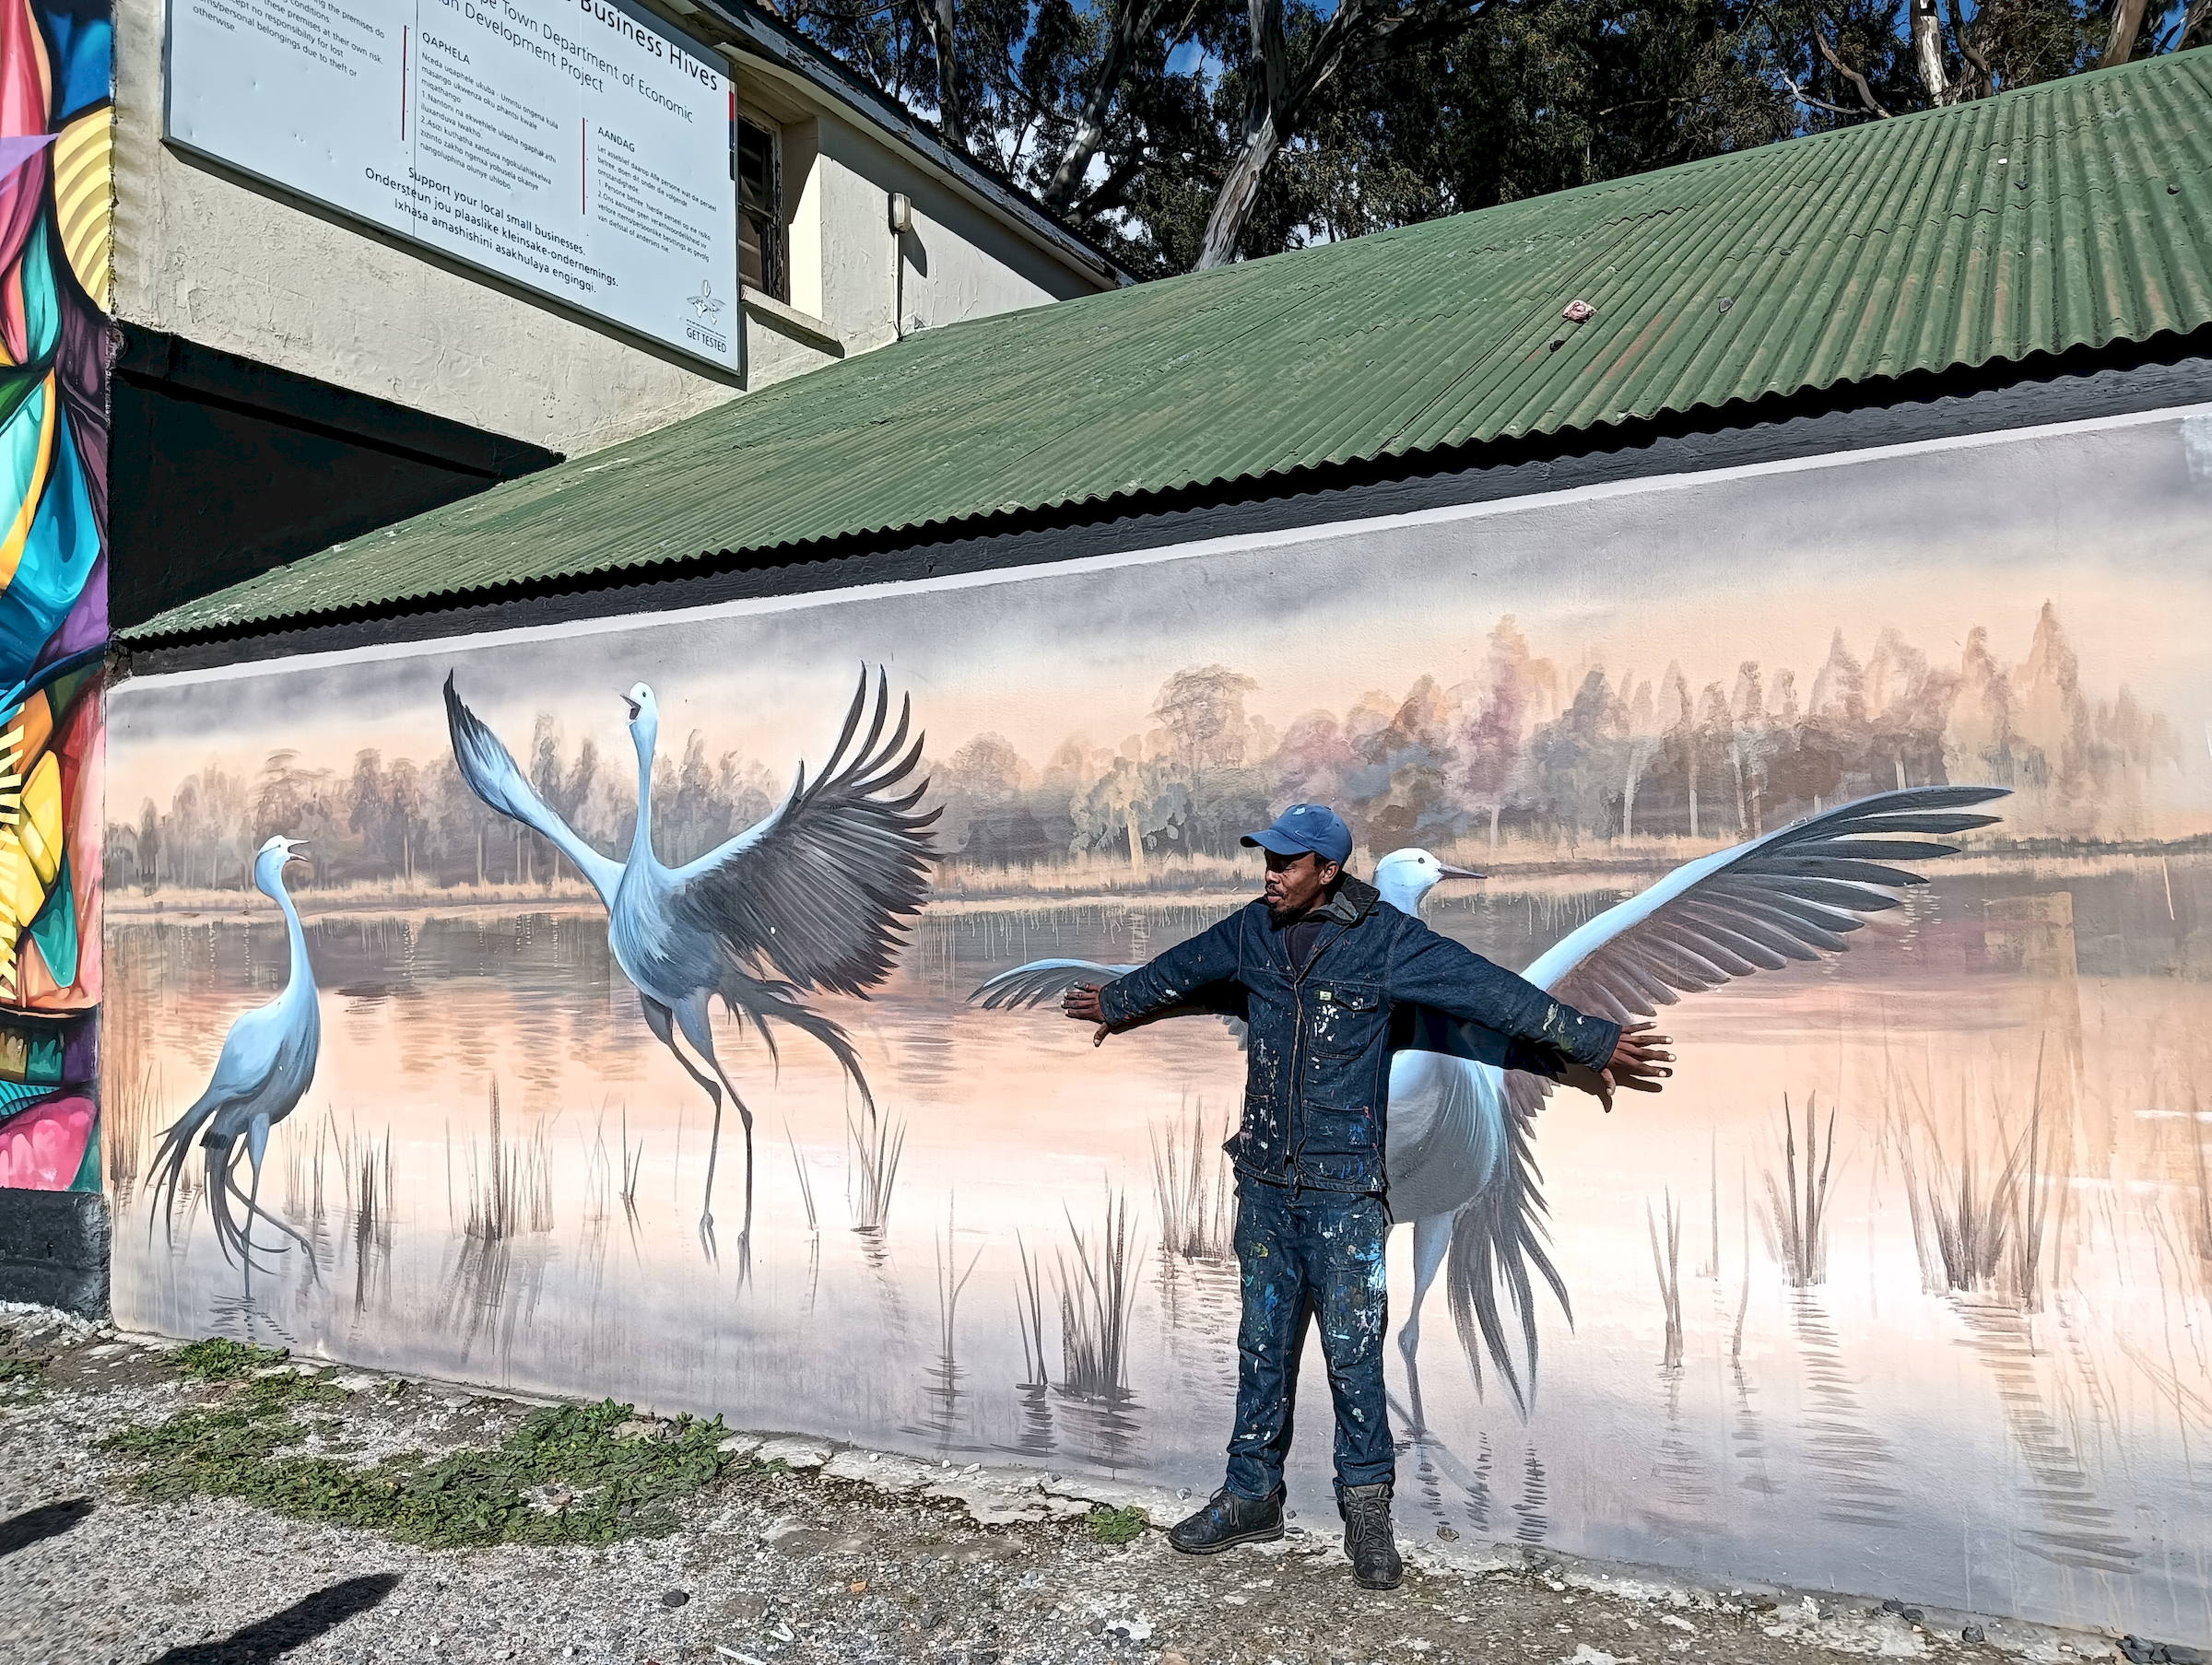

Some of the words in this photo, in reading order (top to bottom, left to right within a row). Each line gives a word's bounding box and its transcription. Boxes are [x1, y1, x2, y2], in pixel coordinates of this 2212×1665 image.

[422, 32, 470, 65] QAPHELA
[464, 2, 557, 67] Development
[560, 56, 604, 93] Project
[501, 0, 538, 32] Town
[543, 23, 618, 80] Department
[622, 73, 634, 88] of
[639, 78, 693, 123] Economic
[580, 0, 663, 57] Business
[668, 41, 718, 91] Hives
[597, 126, 635, 153] AANDAG
[365, 167, 431, 205] Ondersteun
[434, 196, 452, 214] jou
[454, 208, 499, 235] plaaslike
[501, 226, 618, 287] kleinsake-ondernemings.
[394, 198, 429, 222] Ixhasa
[431, 217, 492, 249] amashishini
[495, 243, 549, 274] asakhulaya
[552, 268, 596, 293] engingqi.
[408, 167, 451, 196] Support
[453, 191, 477, 206] your
[480, 199, 504, 219] local
[506, 214, 532, 231] small
[535, 224, 585, 256] businesses.
[686, 327, 700, 341] GET
[701, 334, 727, 353] TESTED
